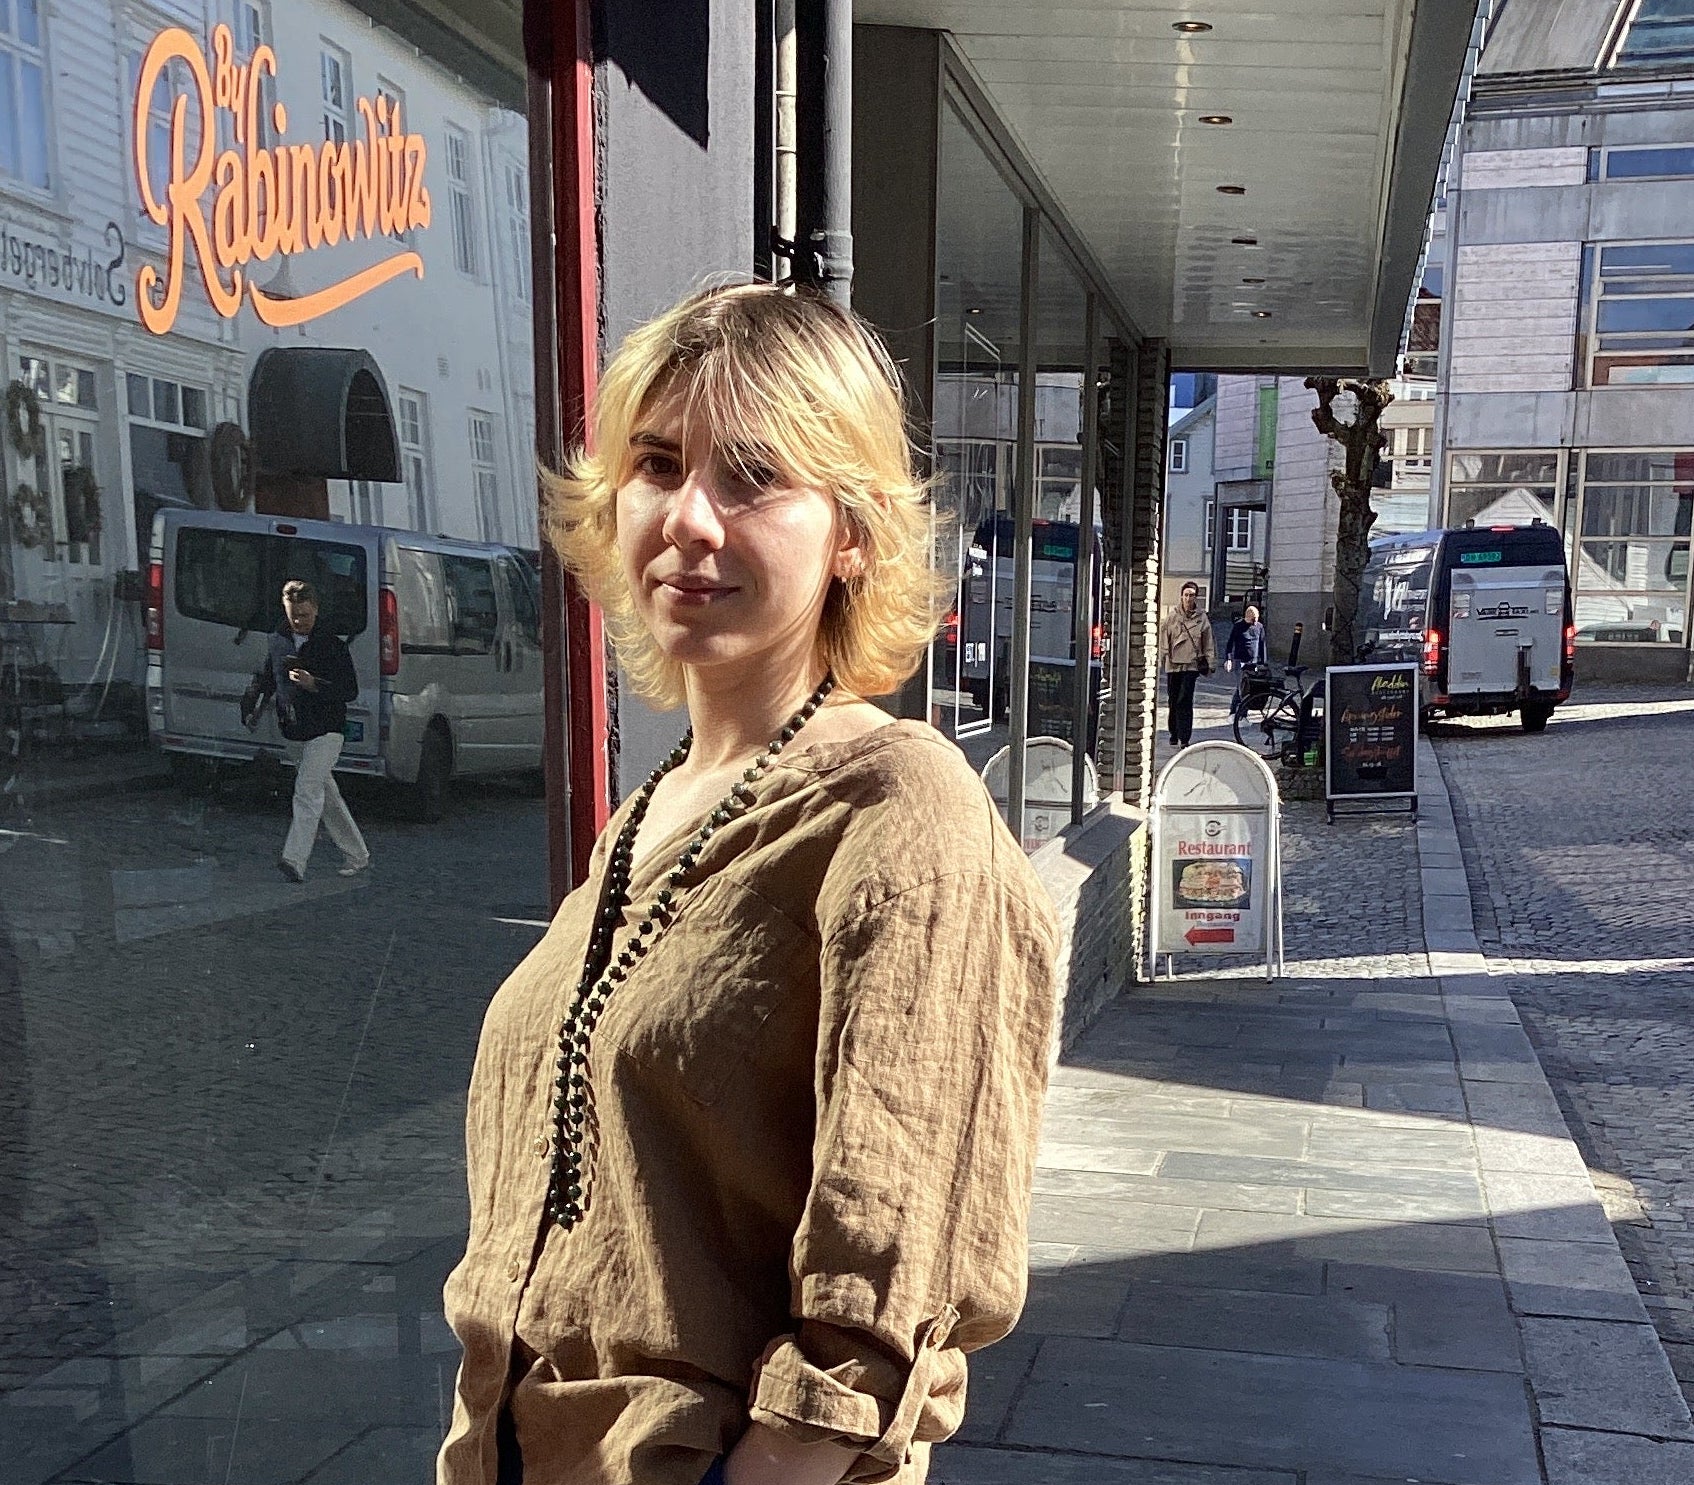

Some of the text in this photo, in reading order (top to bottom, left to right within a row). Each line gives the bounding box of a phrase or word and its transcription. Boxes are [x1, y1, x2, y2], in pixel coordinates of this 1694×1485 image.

[213, 23, 248, 144] By
[135, 27, 431, 336] Rabinowitz
[1178, 840, 1253, 856] Restaurant
[1184, 910, 1241, 922] Inngang
